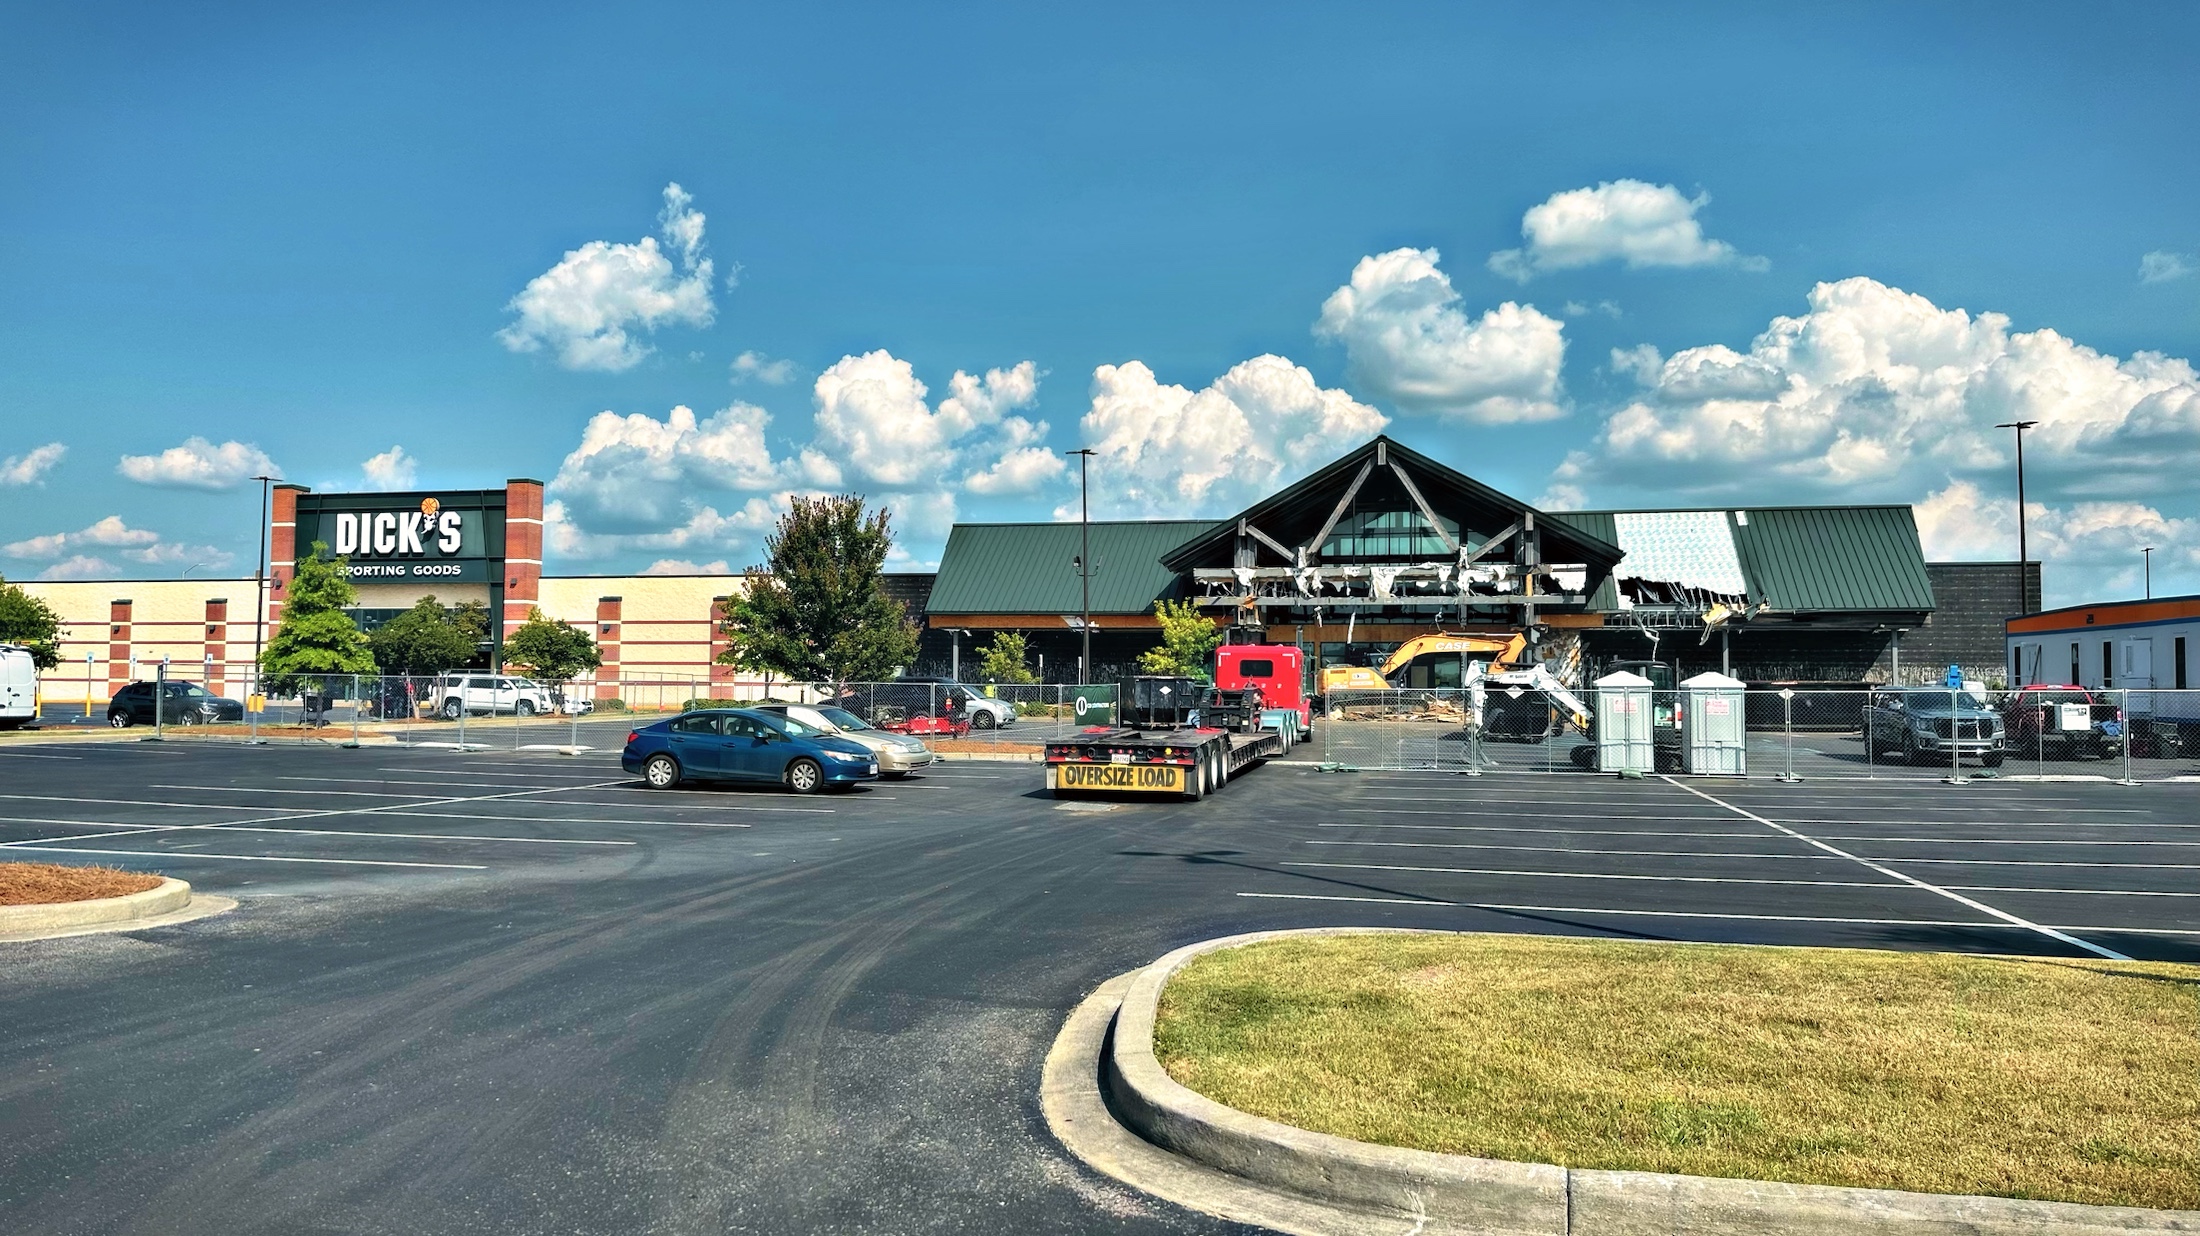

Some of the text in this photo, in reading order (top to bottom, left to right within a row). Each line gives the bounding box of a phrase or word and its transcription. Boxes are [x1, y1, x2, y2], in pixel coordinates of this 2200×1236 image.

[336, 511, 462, 554] DICK'S
[412, 565, 462, 576] GOODS
[1435, 641, 1471, 650] CASE
[1065, 765, 1177, 787] OVERSIZE LOAD
